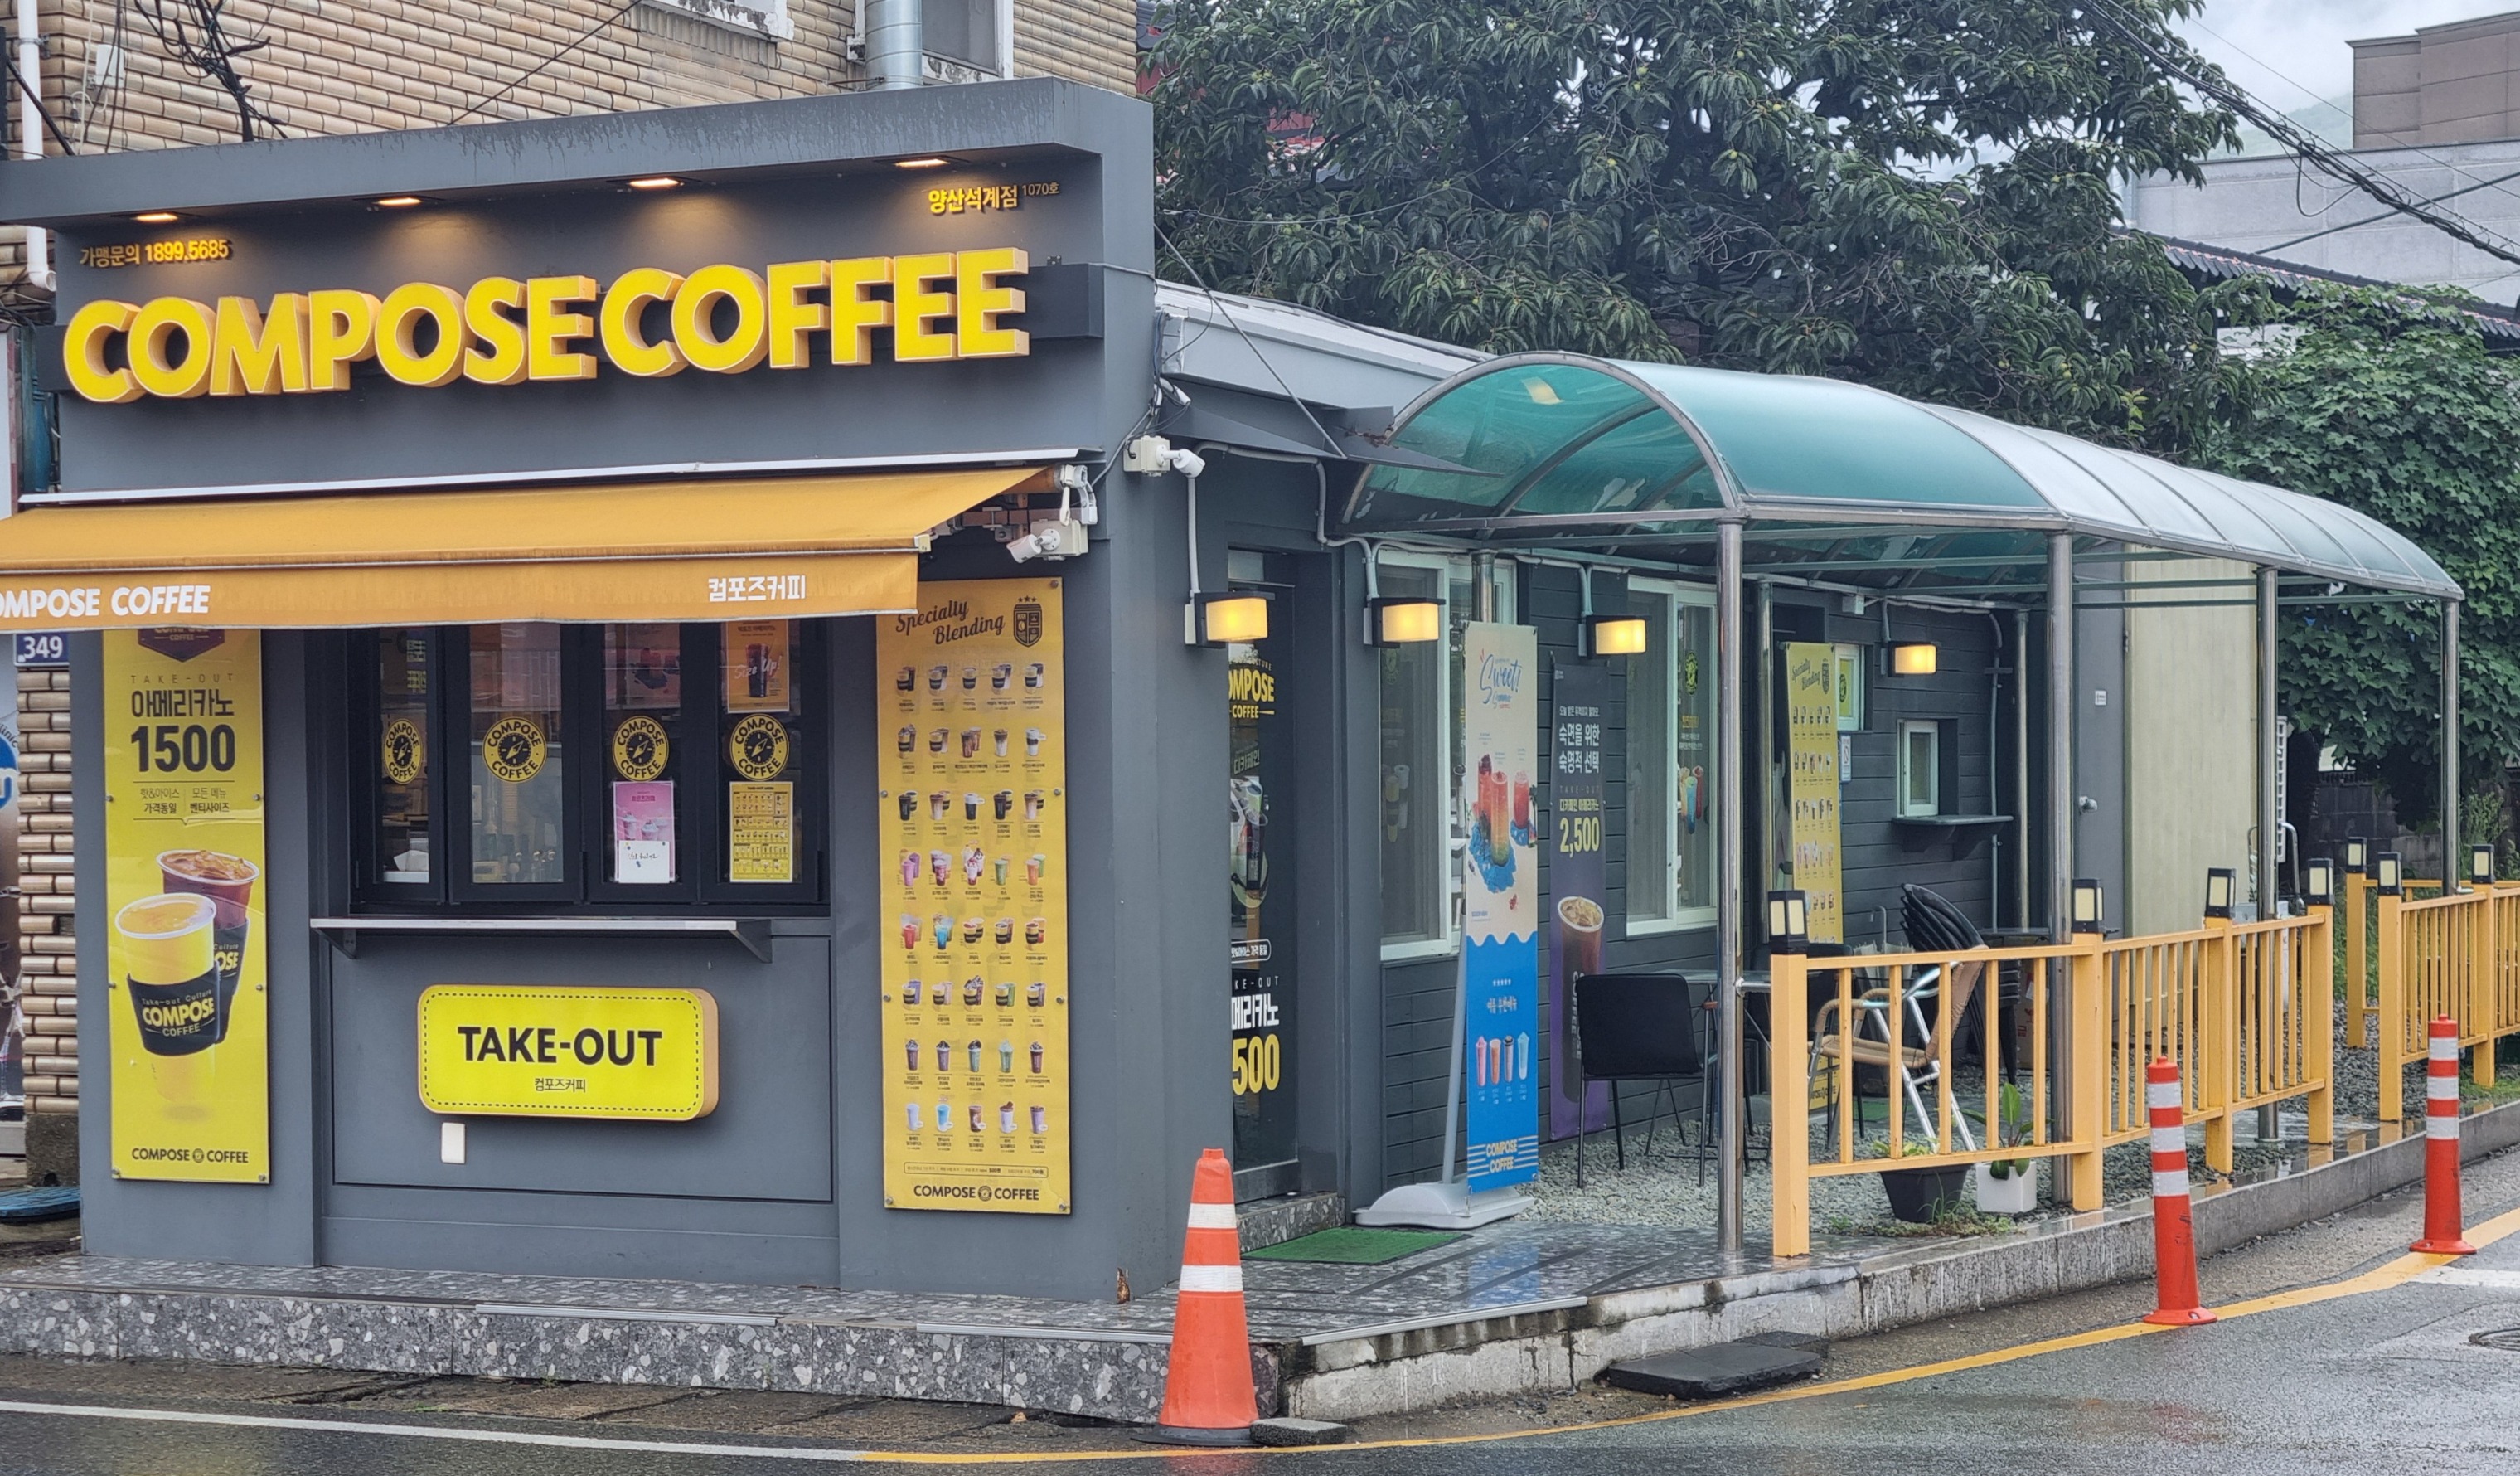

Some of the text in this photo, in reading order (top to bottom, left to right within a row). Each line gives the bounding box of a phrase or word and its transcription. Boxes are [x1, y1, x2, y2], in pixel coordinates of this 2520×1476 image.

[928, 182, 1060, 214] 양산석계점 1070호
[80, 239, 230, 268] 가맹문의 1899.5685
[708, 575, 806, 602] 컴포즈커피
[0, 585, 211, 618] MPOSE COFFEE
[933, 614, 1006, 645] Blending
[23, 635, 64, 659] 349
[131, 672, 235, 684] TAKE-OUT
[1228, 668, 1274, 702] MPOSE
[131, 688, 235, 718] 아메리카노
[1232, 704, 1259, 719] COFFEE
[0, 723, 18, 748] linic
[386, 722, 419, 748] COMPOSE
[487, 721, 542, 747] COMPOSE
[617, 720, 665, 747] COMPOSE
[734, 717, 785, 745] COMPOSE
[1558, 722, 1600, 746] 숙면을 위한
[131, 724, 235, 773] 1500
[389, 761, 417, 779] COFFEE
[492, 760, 539, 779] COFFEE
[620, 759, 662, 779] COFFEE
[738, 757, 782, 778] COFFEE
[1558, 750, 1599, 774] 숙명적 선택
[1558, 816, 1601, 858] 2,500
[1234, 975, 1279, 990] KE-OUT
[143, 997, 215, 1027] COMPOSE
[1231, 993, 1280, 1030] 메리카노
[162, 1022, 201, 1037] COFFEE
[458, 1026, 662, 1066] TAKE-OUT
[1232, 1033, 1280, 1095] 500
[534, 1077, 587, 1093] 컴포즈커피
[132, 1148, 250, 1163] COMPOSE COFFEE
[1486, 1139, 1517, 1157] COMPOSE
[1490, 1156, 1514, 1173] COFFEE
[914, 1184, 1040, 1201] COMPOSE COFFEE
